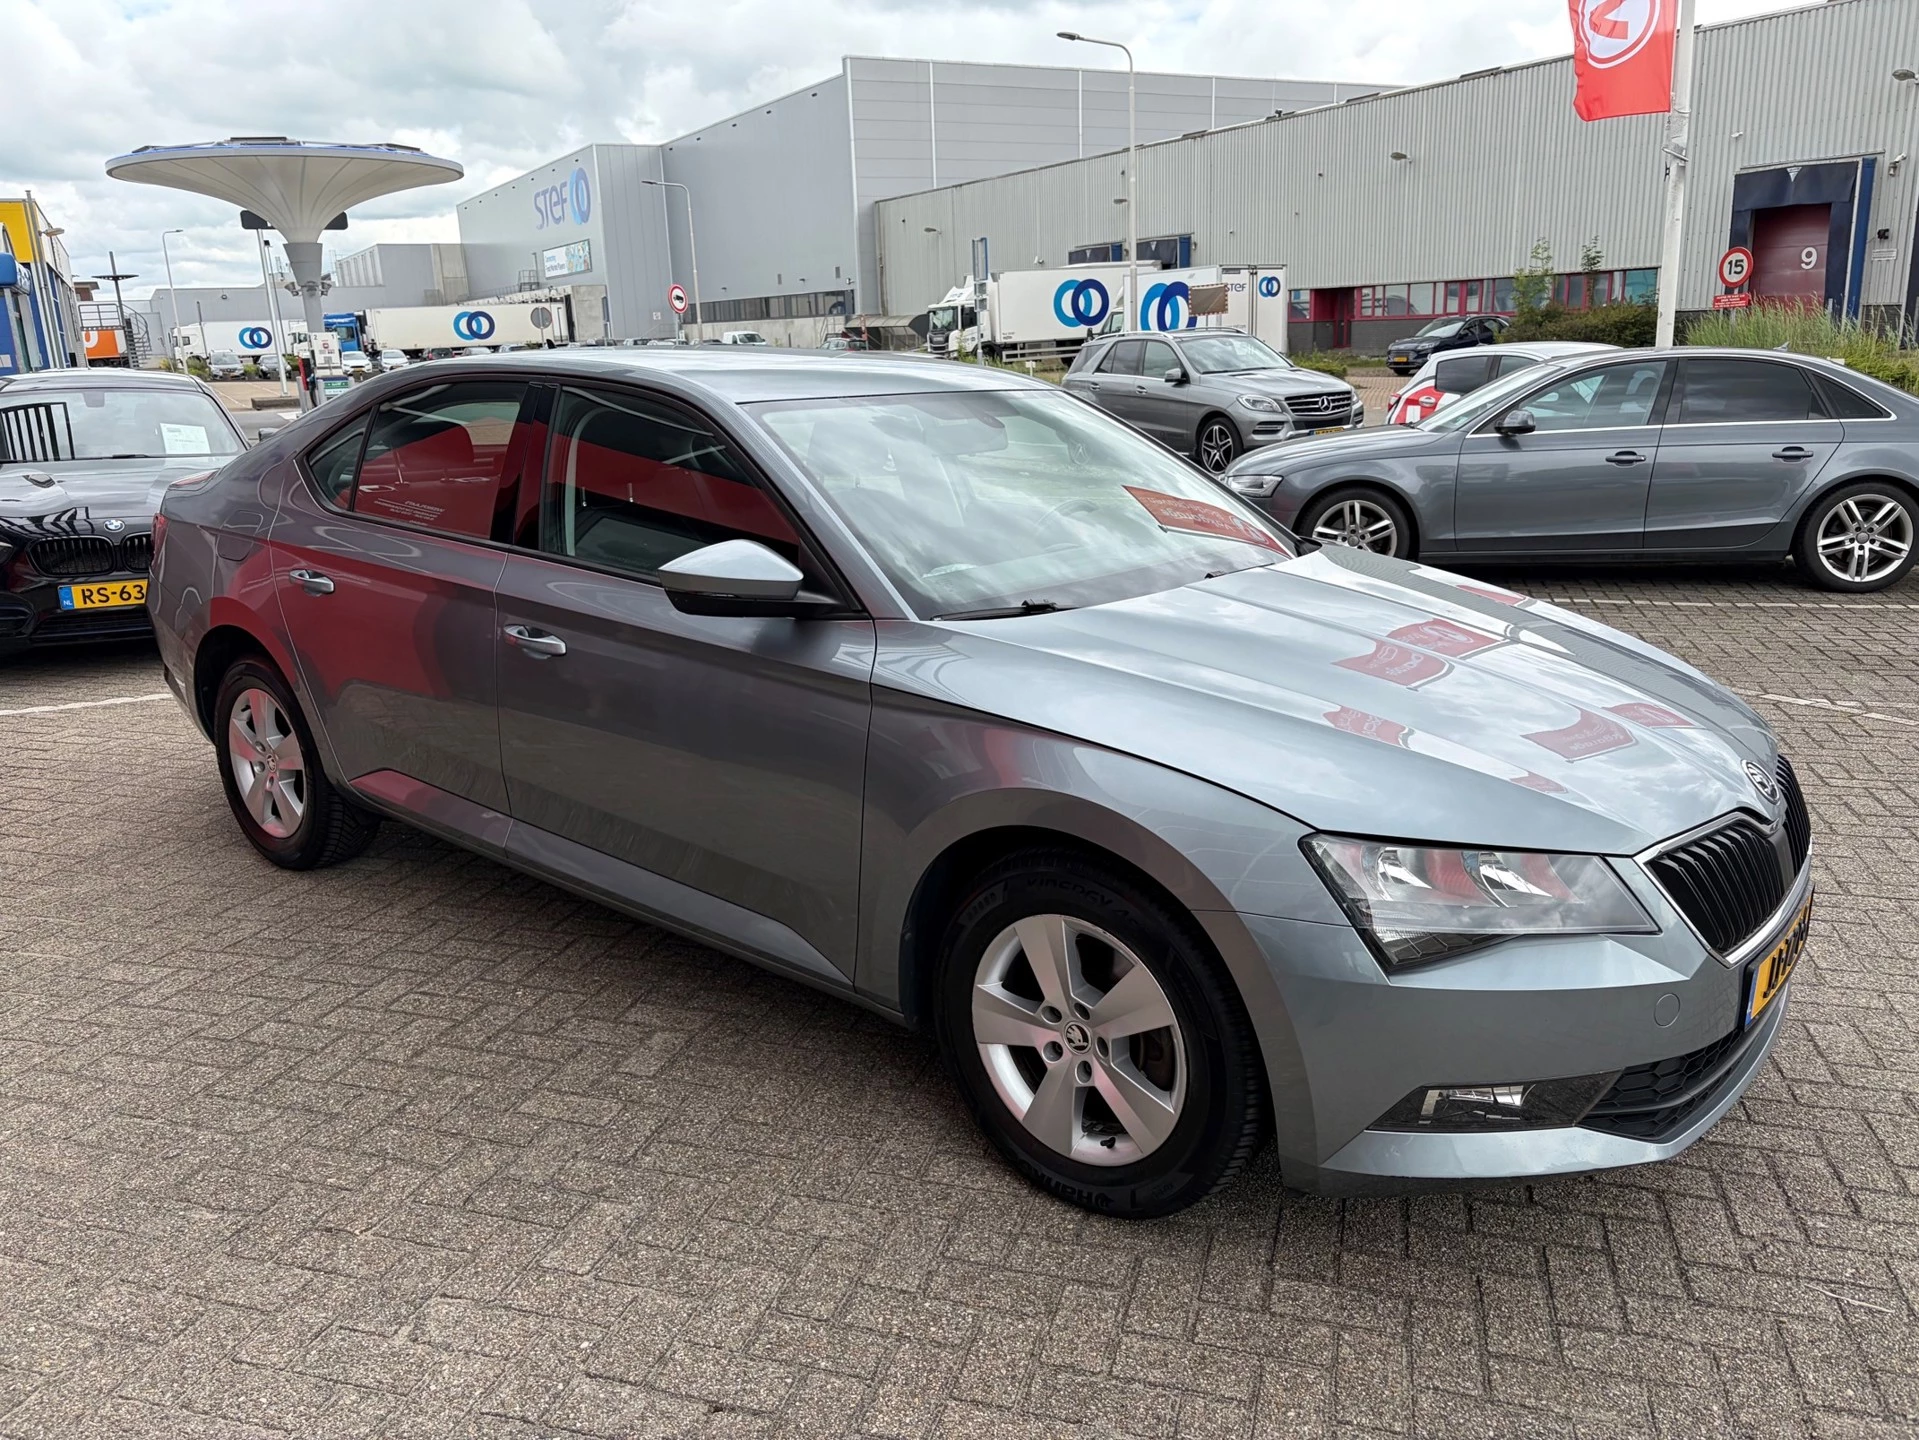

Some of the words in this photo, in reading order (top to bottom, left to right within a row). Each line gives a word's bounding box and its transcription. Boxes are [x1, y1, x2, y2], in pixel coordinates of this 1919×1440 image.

[1728, 259, 1744, 275] 15
[1801, 247, 1818, 270] 9
[81, 584, 145, 605] RS-63
